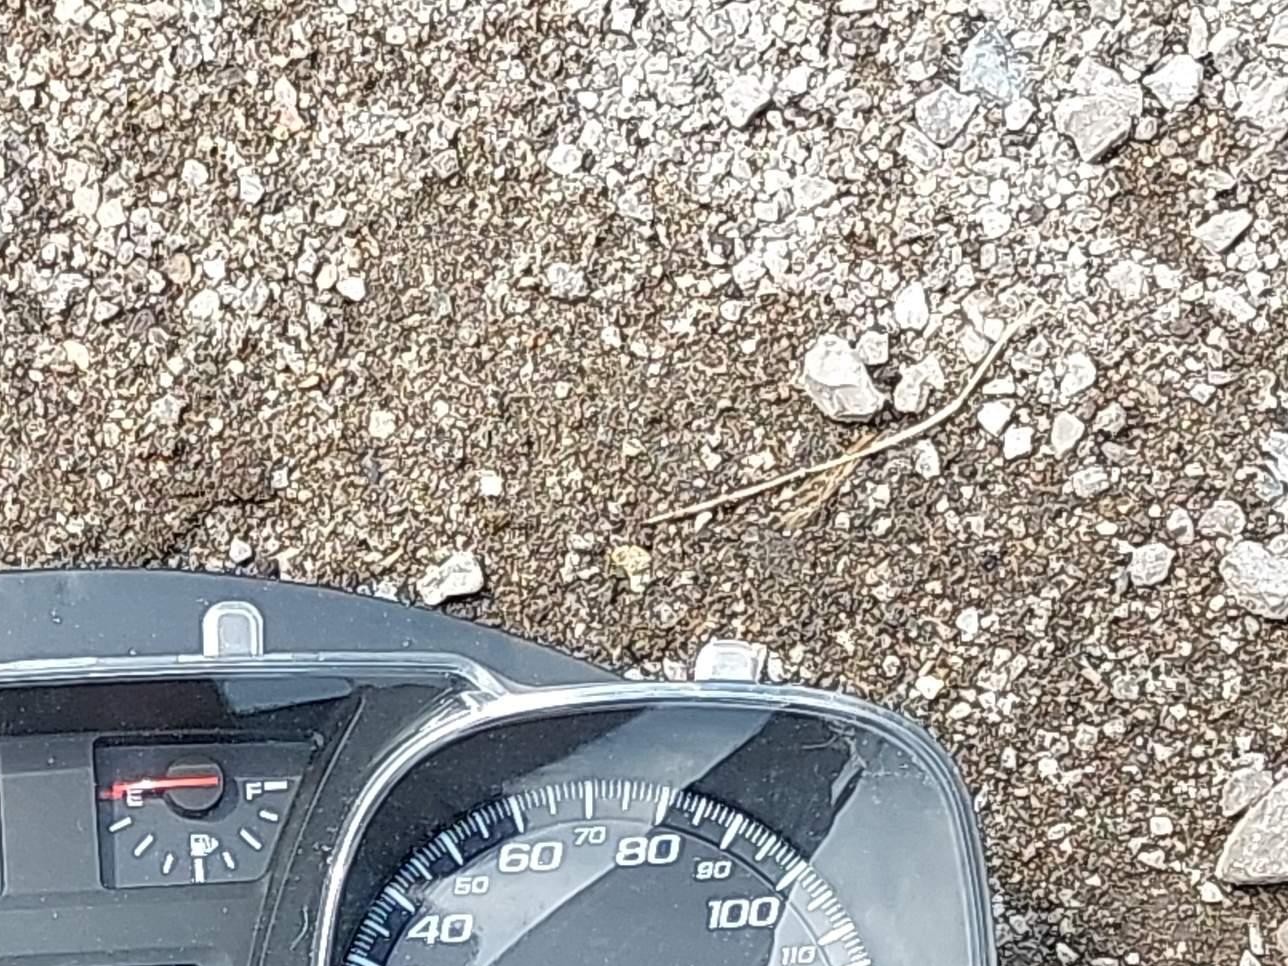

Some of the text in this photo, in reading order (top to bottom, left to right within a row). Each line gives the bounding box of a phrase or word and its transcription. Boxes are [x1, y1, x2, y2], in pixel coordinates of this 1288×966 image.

[127, 786, 143, 807] E
[246, 782, 262, 800] F
[575, 827, 606, 845] 70
[499, 843, 564, 873] 60
[616, 835, 681, 866] 80
[696, 861, 731, 880] 90
[454, 875, 489, 894] 50
[707, 897, 780, 930] 100
[408, 913, 473, 944] 40
[782, 946, 816, 965] 110
